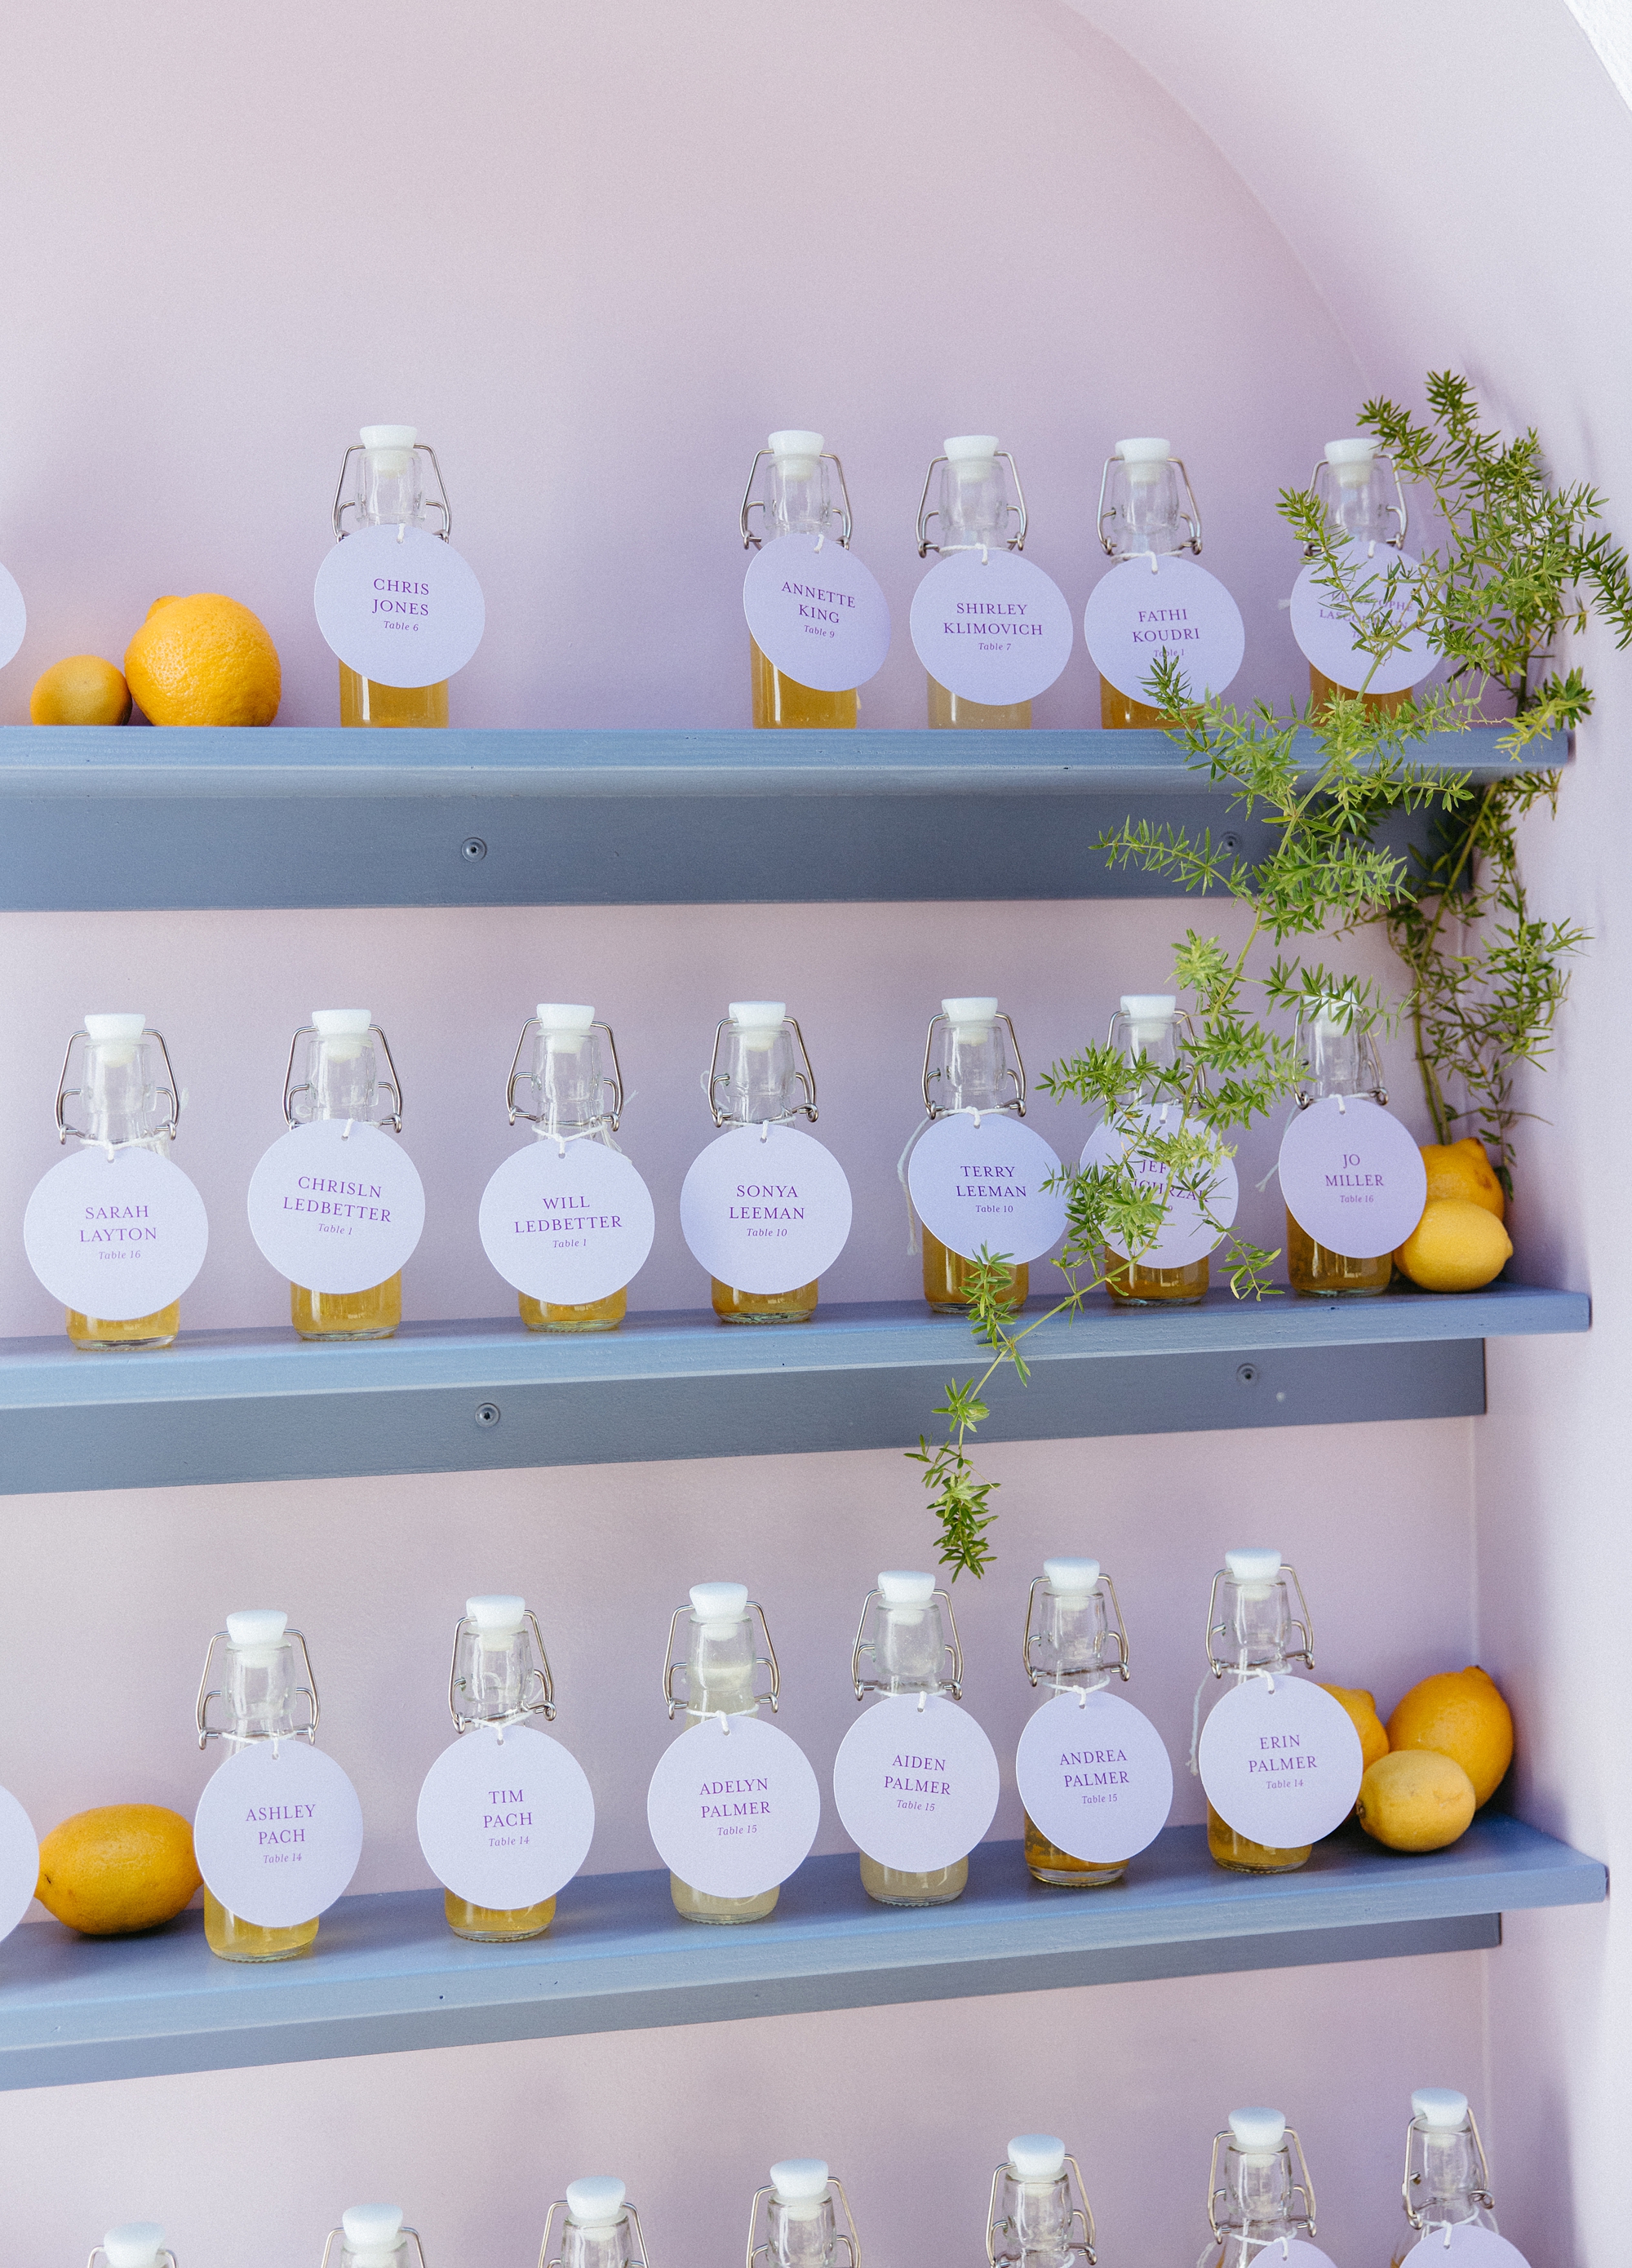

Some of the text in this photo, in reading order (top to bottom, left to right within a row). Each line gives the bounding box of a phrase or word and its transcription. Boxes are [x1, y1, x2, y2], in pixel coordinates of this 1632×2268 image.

[373, 578, 429, 596] CHRIS
[781, 581, 856, 609] ANNETTE
[371, 598, 429, 616] JONES
[799, 605, 840, 624] KING
[956, 602, 1027, 615] SHIRLEY
[1138, 608, 1188, 623] FATHI
[383, 619, 410, 631] Table
[804, 624, 827, 637] Table
[943, 622, 1043, 636] KLIMOVICH
[1132, 628, 1200, 643] KOUDRI
[978, 641, 1004, 651] Table
[1342, 1153, 1361, 1170] JO
[960, 1165, 1015, 1178] TERRY
[298, 1176, 382, 1199] CHRISLN
[1324, 1174, 1385, 1187] MILLER
[736, 1184, 799, 1198] SONYA
[956, 1185, 1027, 1197] LEEMAN
[542, 1196, 591, 1210] WILL
[1339, 1194, 1374, 1204] Table 16
[85, 1205, 149, 1220] SARAH
[283, 1196, 392, 1223] LEDBETTER
[729, 1206, 805, 1220] LEEMAN
[975, 1205, 1014, 1214] Table 10
[318, 1223, 345, 1235] Table
[514, 1215, 623, 1234] LEDBETTER
[746, 1227, 788, 1237] Table 10
[79, 1227, 157, 1243] LAYTON
[552, 1239, 580, 1249] Table
[99, 1249, 141, 1260] Table 16
[1259, 1734, 1301, 1751] ERIN
[891, 1754, 946, 1772] AIDEN
[1059, 1749, 1128, 1766] ANDREA
[1248, 1755, 1318, 1773] PALMER
[699, 1778, 768, 1795] ADELYN
[884, 1775, 951, 1795] PALMER
[1063, 1770, 1130, 1788] PALMER
[1266, 1778, 1304, 1790] Table 14
[488, 1789, 524, 1804] TIM
[1081, 1793, 1118, 1804] Table 15
[245, 1804, 316, 1822] ASHLEY
[701, 1800, 771, 1819] PALMER
[896, 1799, 936, 1812] Table 15
[483, 1812, 533, 1829] PACH
[258, 1828, 305, 1845] PACH
[716, 1824, 758, 1836] Table 15
[488, 1835, 530, 1848] Table 14
[263, 1853, 303, 1864] Table 14
